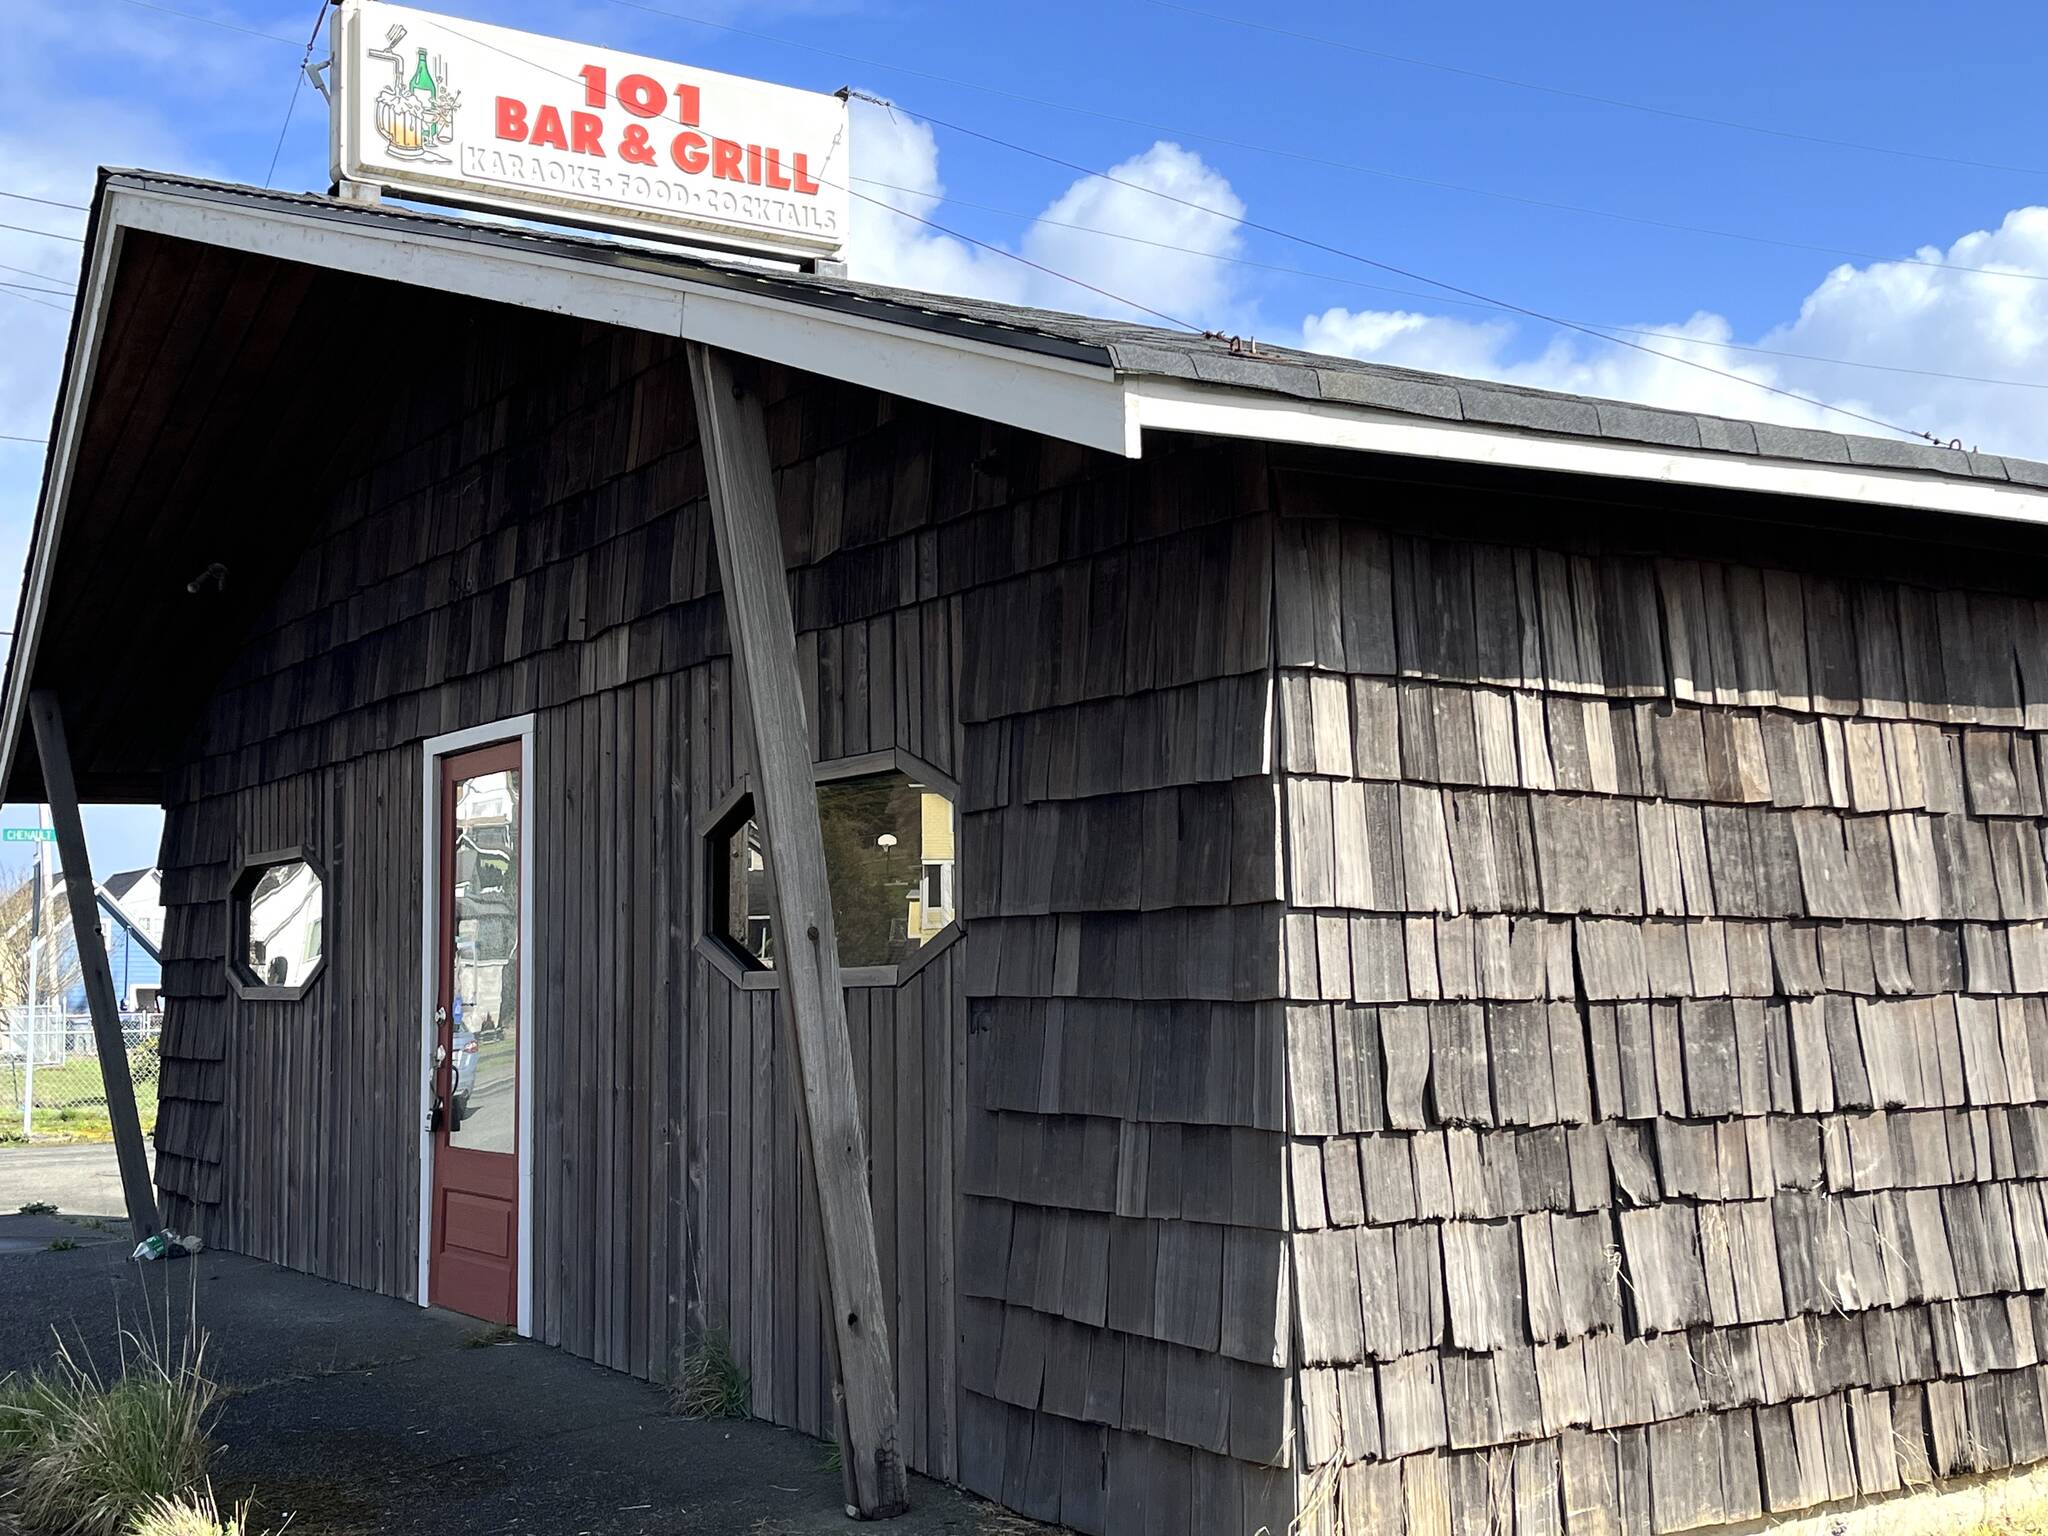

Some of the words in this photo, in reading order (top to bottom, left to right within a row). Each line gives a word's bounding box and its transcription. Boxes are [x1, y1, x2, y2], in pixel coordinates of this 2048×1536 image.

[579, 63, 701, 128] 101
[467, 145, 602, 192] KARAOKE
[616, 172, 690, 206] FOOD
[705, 188, 837, 231] COCKTAILS
[495, 95, 607, 159] BAR
[618, 123, 657, 168] &
[670, 130, 821, 197] GRILL
